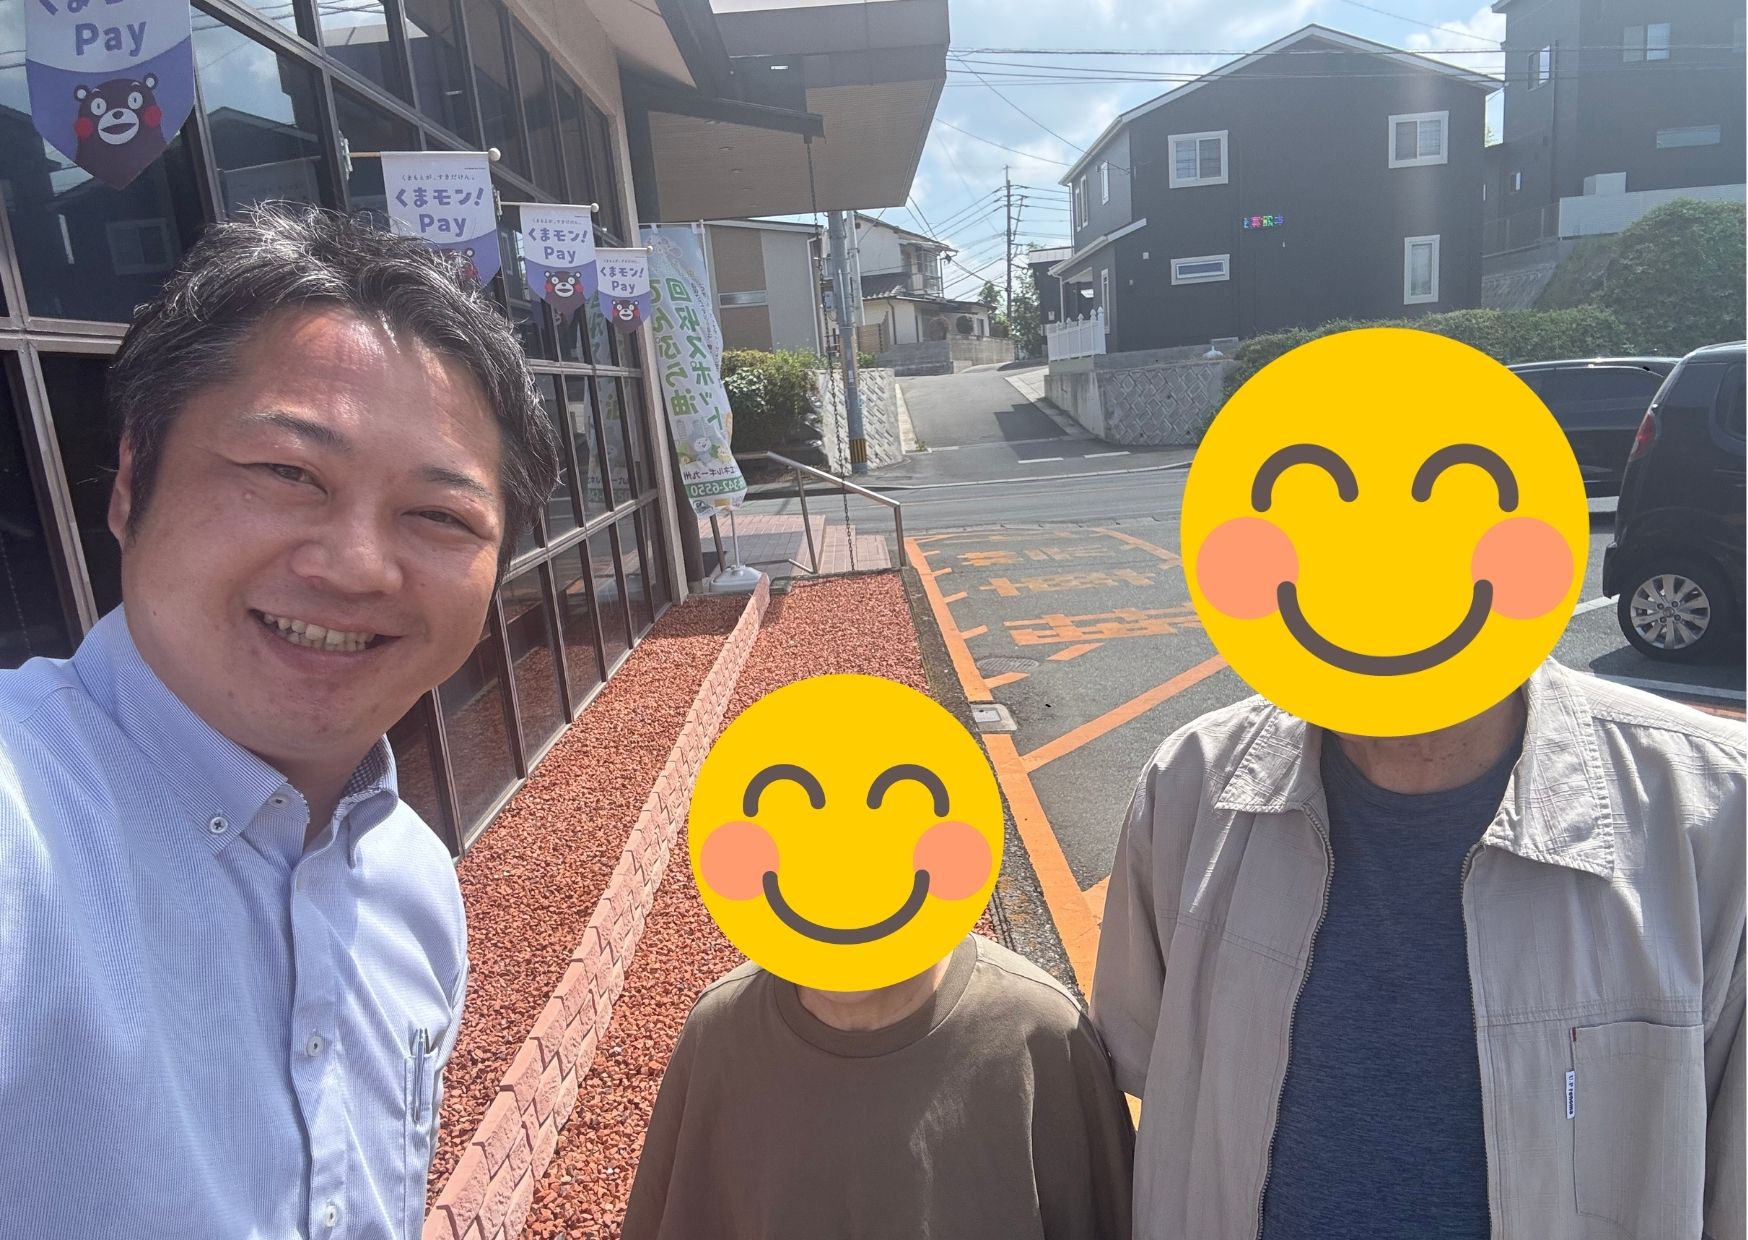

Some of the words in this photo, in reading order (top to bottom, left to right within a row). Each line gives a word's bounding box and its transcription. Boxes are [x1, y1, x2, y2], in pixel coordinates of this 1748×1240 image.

[75, 21, 147, 57] Pay
[395, 187, 484, 208] くまモン!
[418, 213, 467, 238] Pay
[528, 227, 588, 243] くまモン!
[544, 246, 576, 264] Pay
[600, 265, 645, 278] くまモン!
[611, 280, 636, 295] Pay
